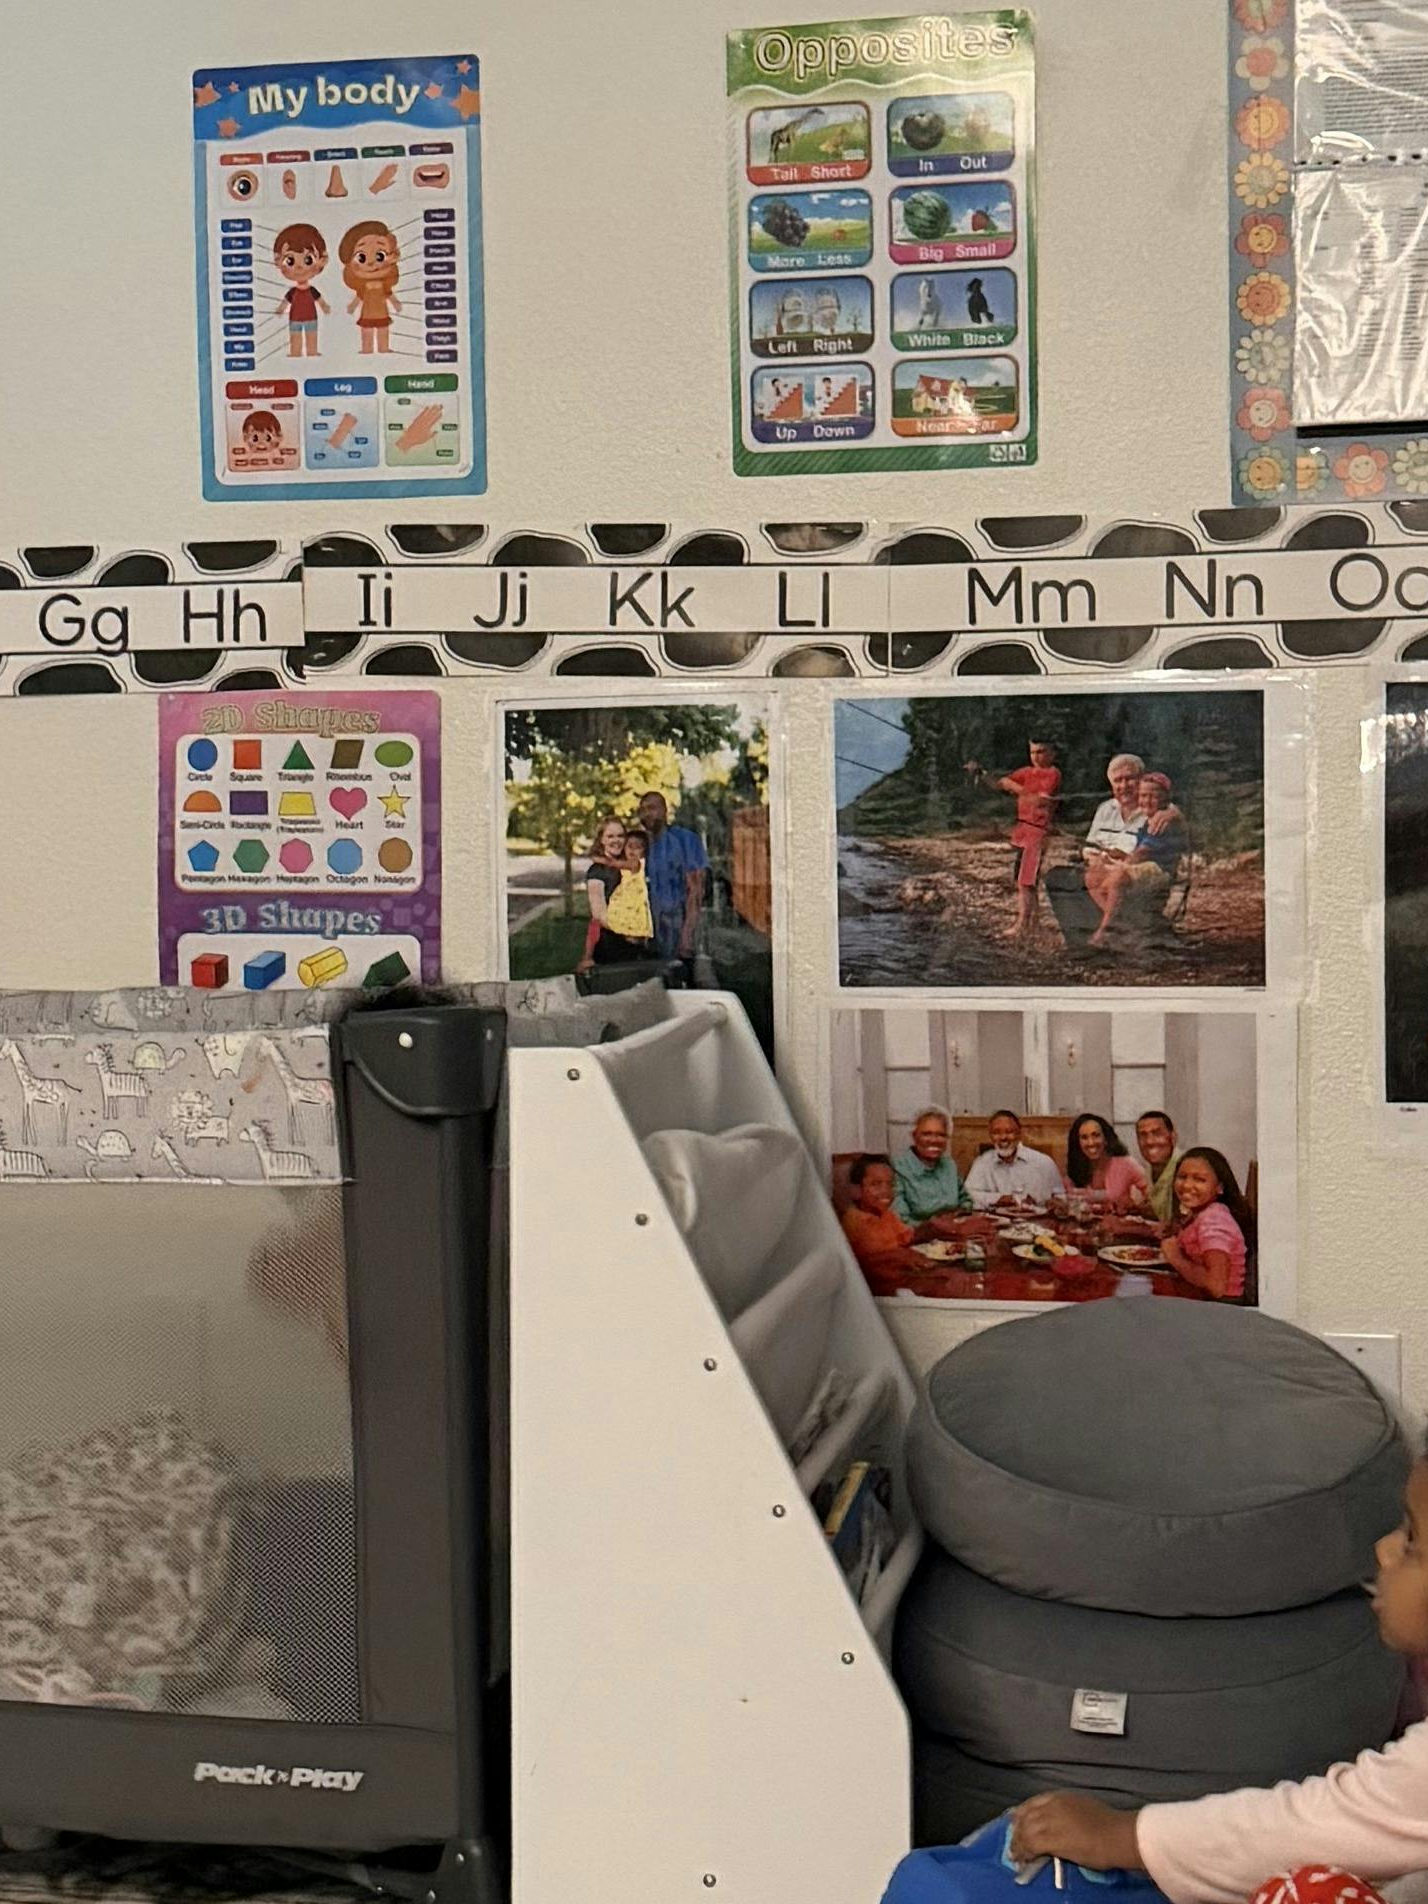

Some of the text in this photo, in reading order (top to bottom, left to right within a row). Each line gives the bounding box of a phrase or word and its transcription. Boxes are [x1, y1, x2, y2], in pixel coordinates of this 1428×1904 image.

[755, 19, 1018, 81] Opposites
[248, 73, 420, 118] My body
[810, 163, 853, 181] Short
[919, 155, 988, 173] In Out
[766, 251, 852, 269] More Less
[918, 242, 997, 263] Big Small
[768, 336, 854, 355] Left Right
[907, 330, 1006, 348] White Black
[775, 423, 855, 442] Up Down
[39, 593, 129, 656] Gg
[182, 588, 267, 644] Hh
[358, 572, 393, 627] Ii
[472, 571, 529, 628] Jj
[608, 570, 695, 628] Kk
[778, 571, 830, 628] Ll
[969, 565, 1096, 626] Mm
[1165, 558, 1265, 620] Nn
[202, 700, 381, 738] 2D Shapes
[187, 773, 213, 782] Circle
[230, 773, 263, 782] Square
[278, 773, 314, 782] Triangle
[390, 773, 411, 782] Oval
[335, 821, 405, 830] Heart Star
[326, 875, 368, 884] Octagon
[202, 900, 381, 940] 3D Shapes
[194, 1762, 364, 1791] Pack Play
